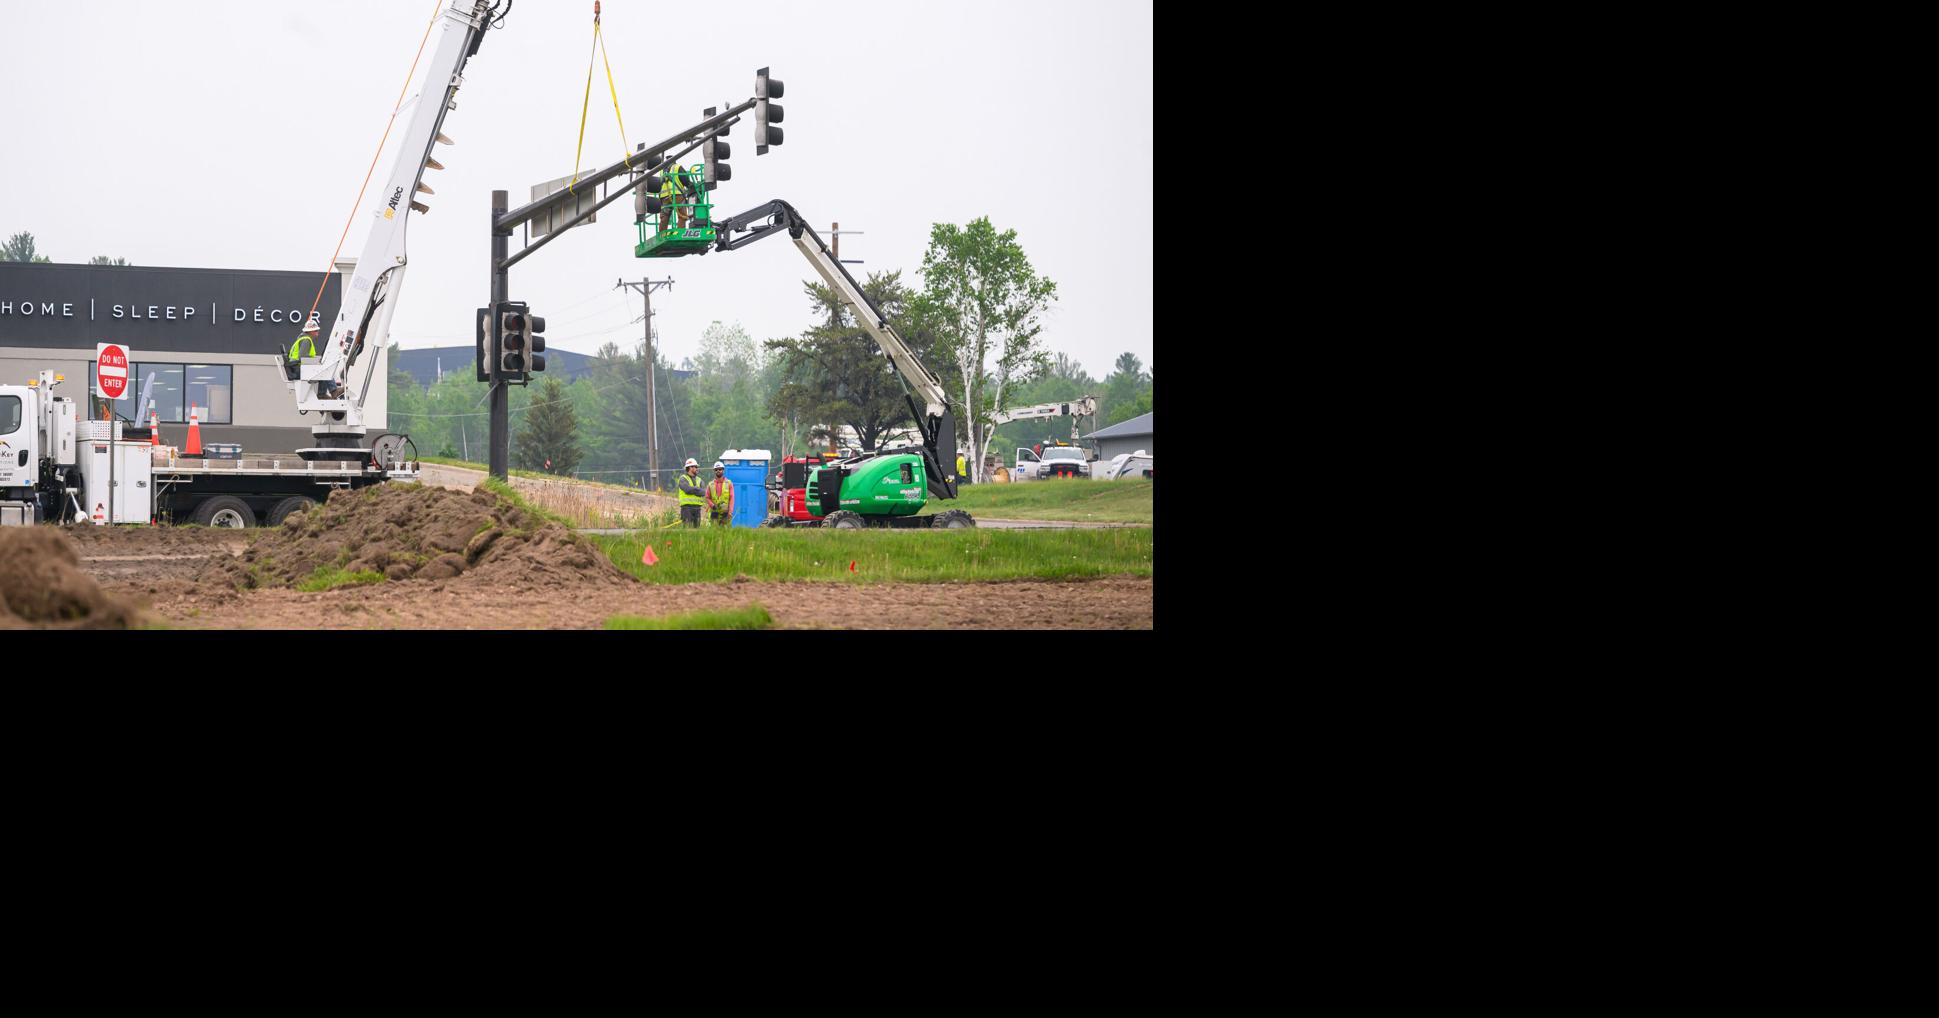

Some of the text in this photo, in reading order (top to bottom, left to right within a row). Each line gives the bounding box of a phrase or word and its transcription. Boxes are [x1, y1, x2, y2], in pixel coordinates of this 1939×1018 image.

[388, 186, 403, 210] Altec
[682, 229, 701, 238] JLG
[1, 301, 321, 324] HOME SLEEP DÉCOR
[102, 355, 124, 364] DO NOT
[104, 378, 123, 388] ENTER
